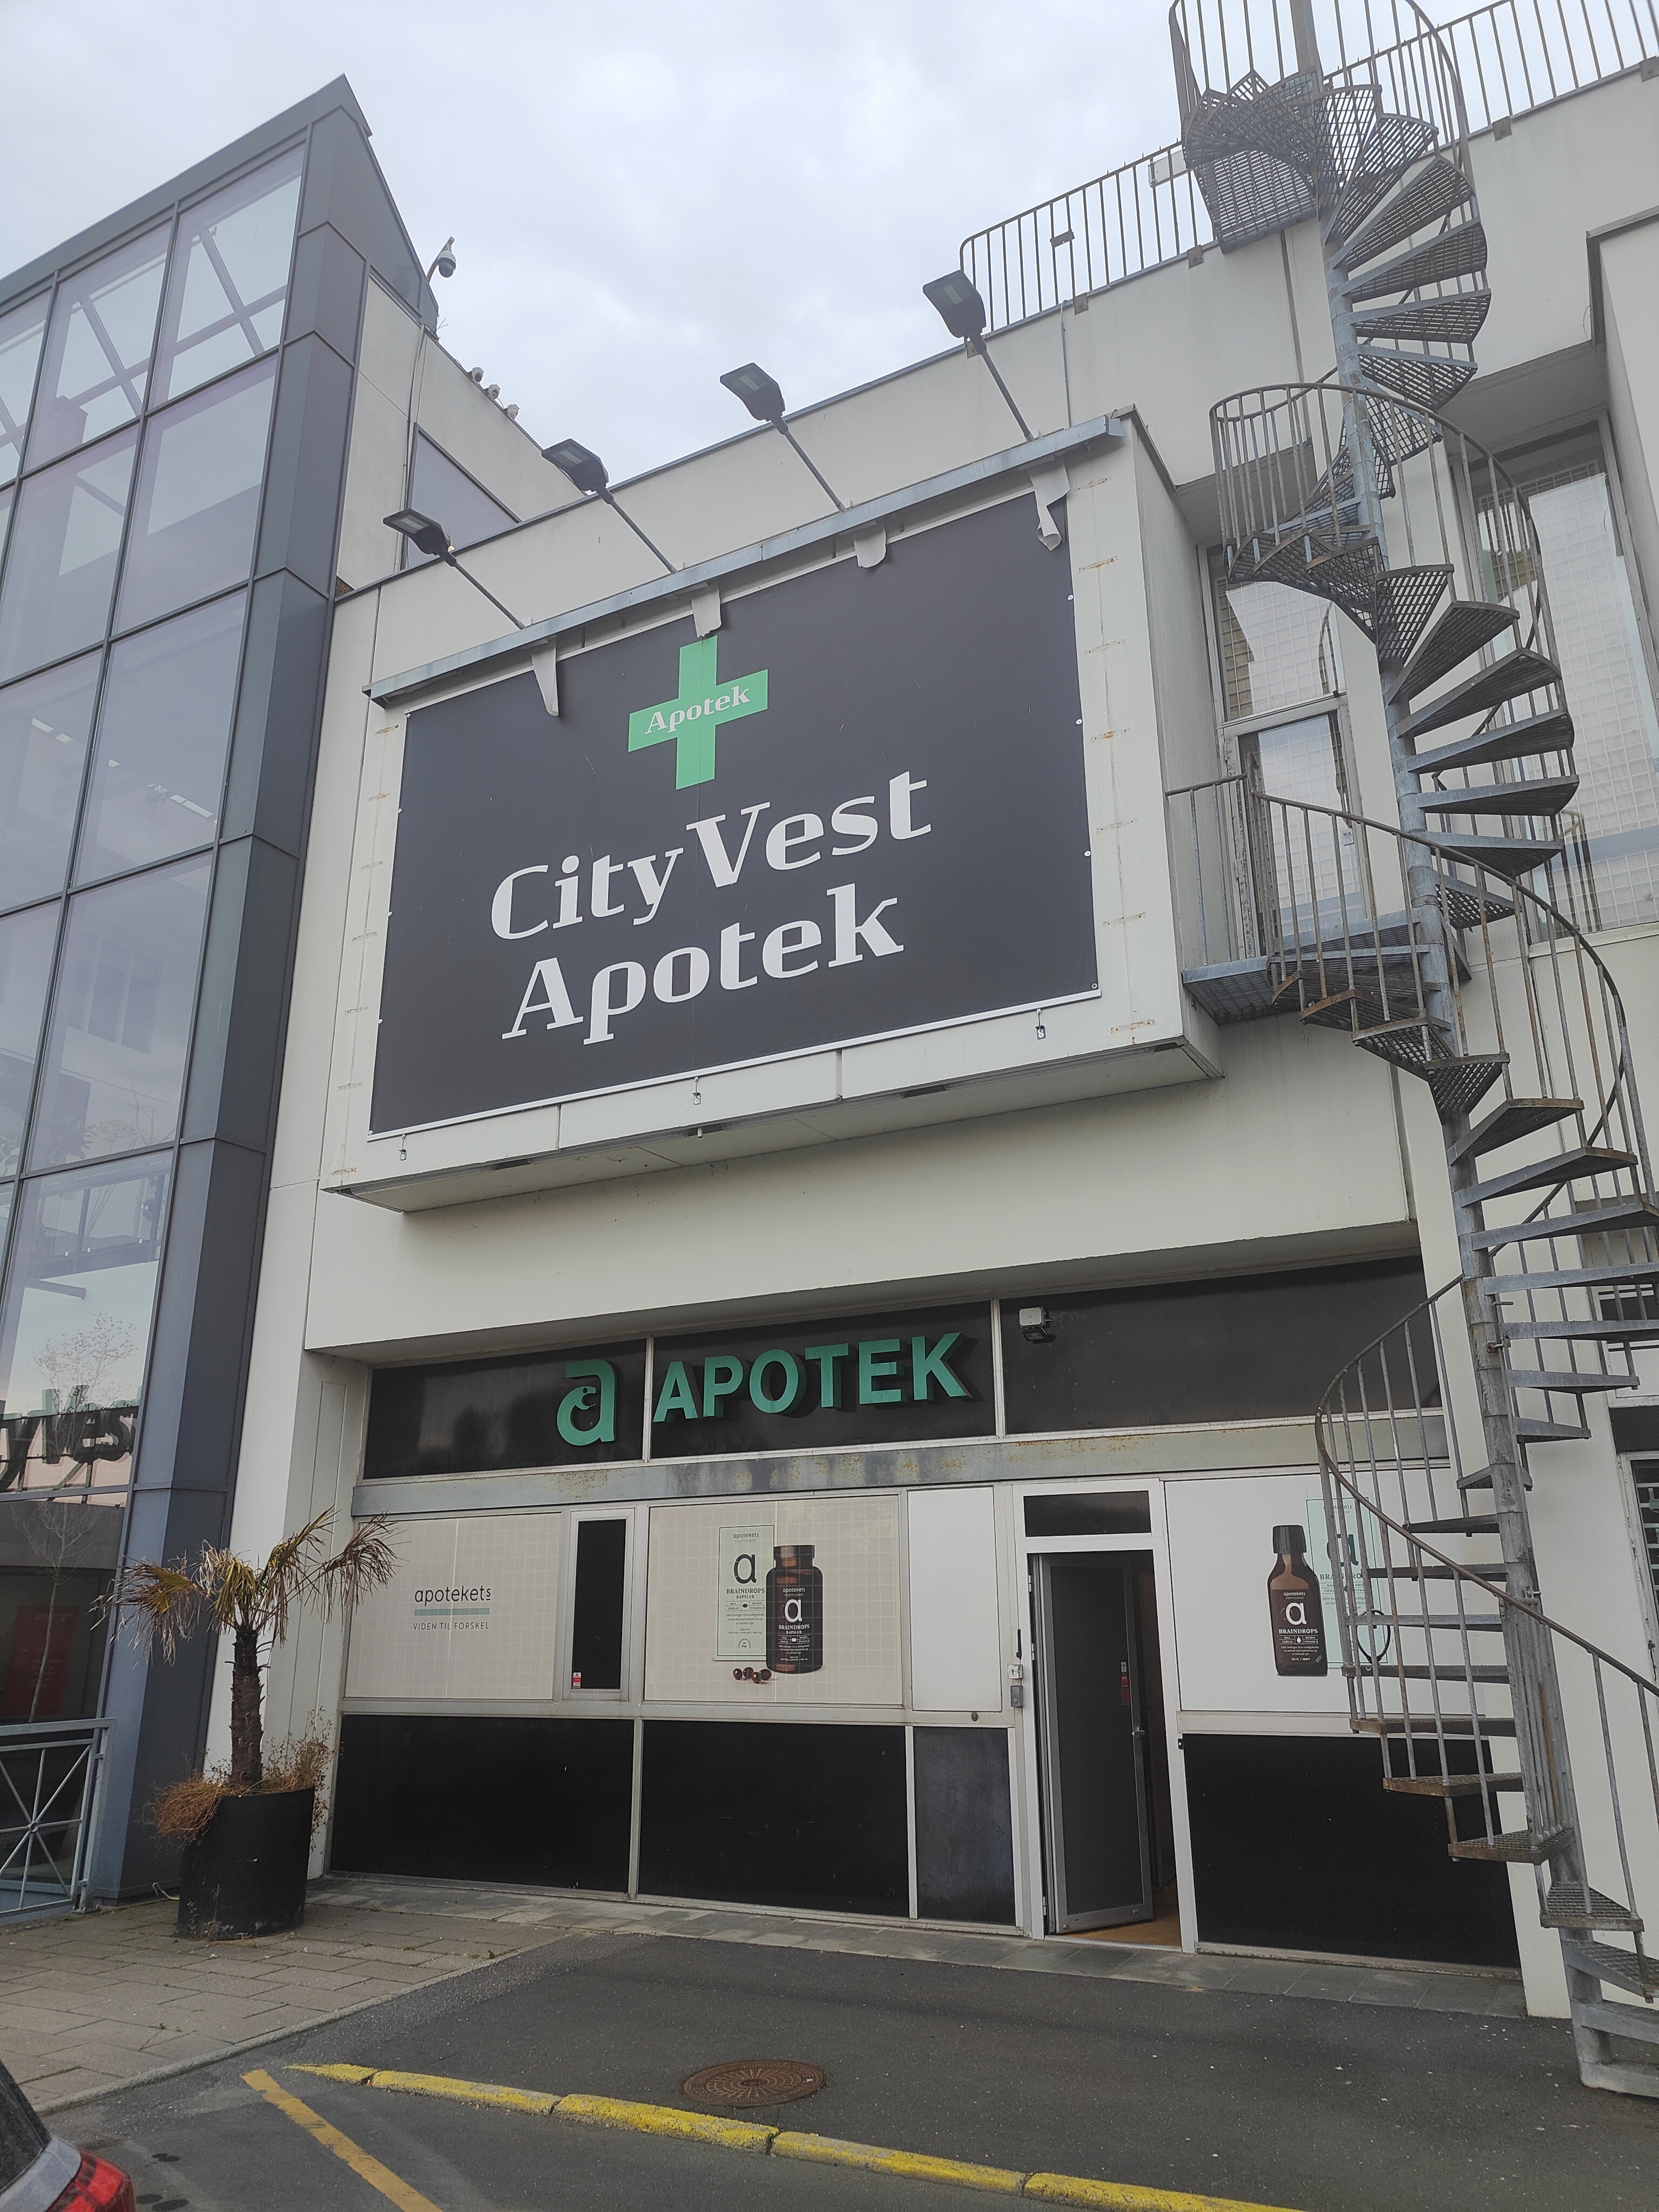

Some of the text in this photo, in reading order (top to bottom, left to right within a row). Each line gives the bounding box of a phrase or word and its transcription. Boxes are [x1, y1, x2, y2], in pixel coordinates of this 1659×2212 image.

[645, 685, 751, 734] Apotek
[491, 771, 932, 940] City Vest
[502, 882, 905, 1046] Apotek
[653, 1332, 970, 1423] APOTEK
[733, 1554, 757, 1584] a
[415, 1585, 491, 1607] apotekets
[784, 1599, 802, 1623] a
[454, 1622, 489, 1630] FORSKEL
[1285, 1602, 1307, 1625] a
